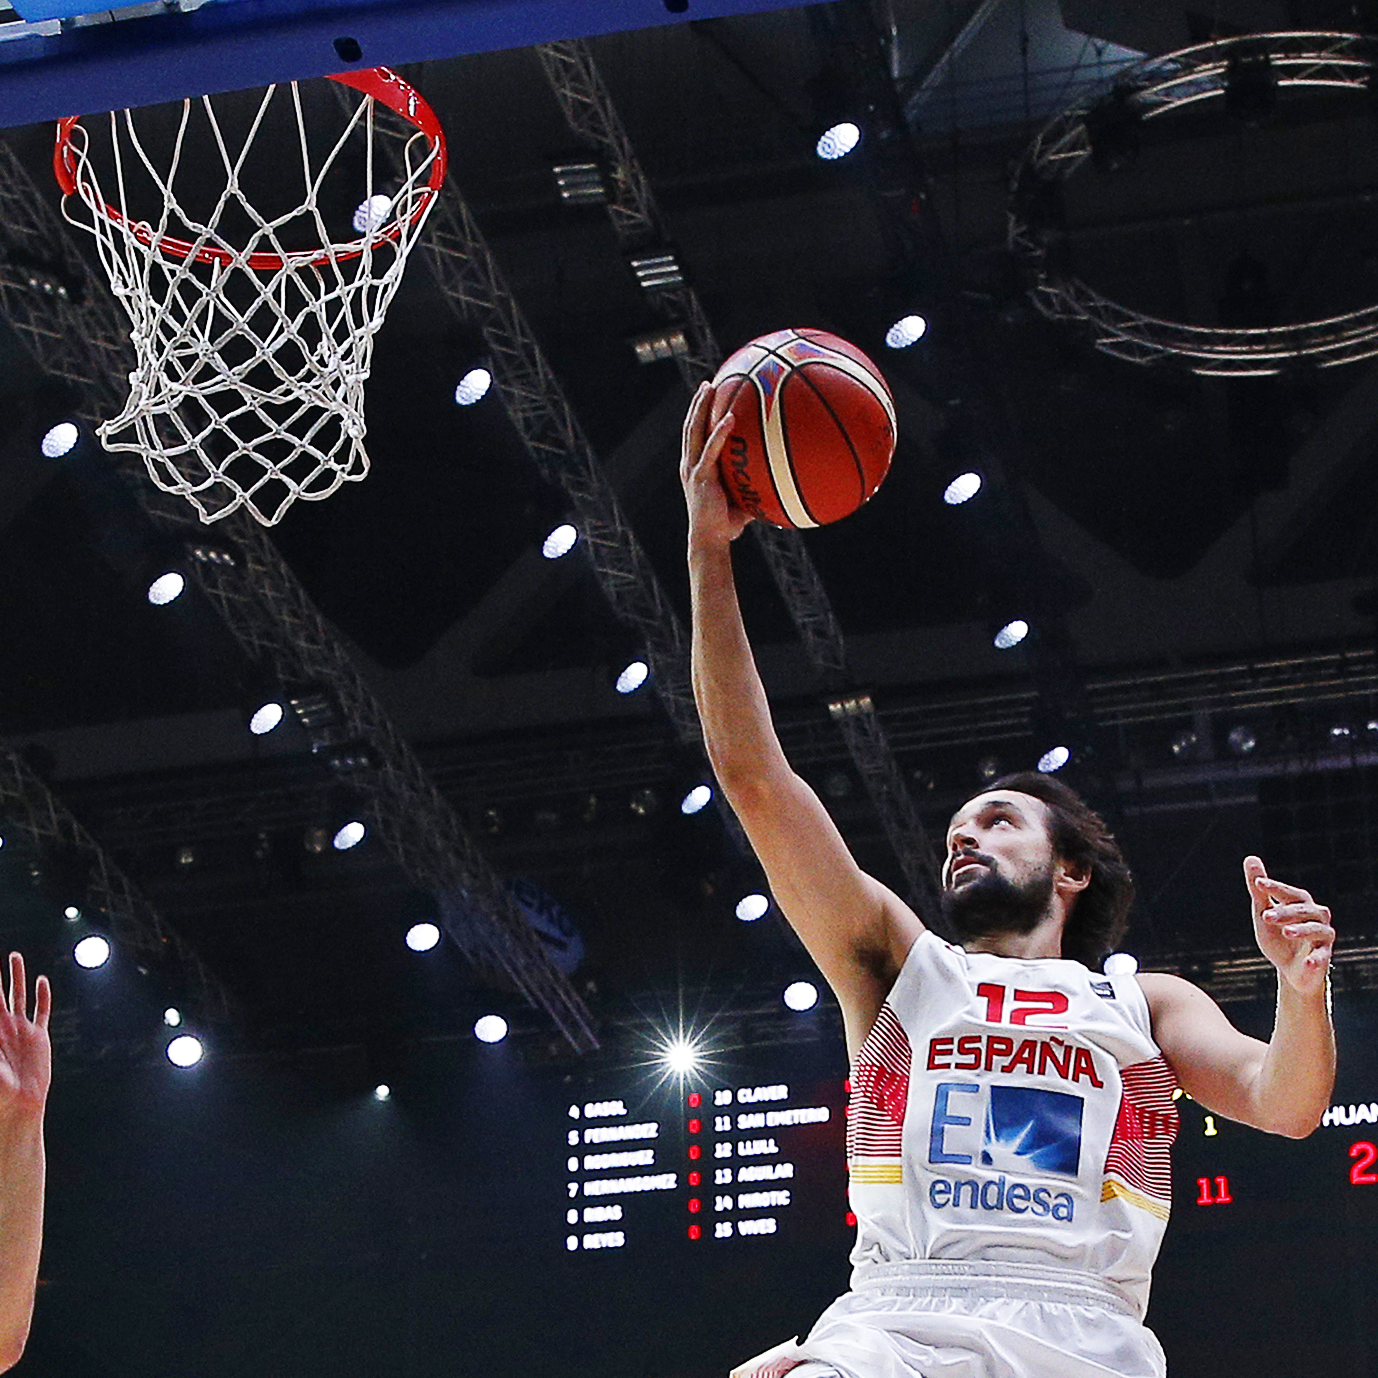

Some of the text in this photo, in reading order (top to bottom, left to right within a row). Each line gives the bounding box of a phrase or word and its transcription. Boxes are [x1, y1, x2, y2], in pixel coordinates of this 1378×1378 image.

[977, 982, 1069, 1029] 12
[927, 1035, 1104, 1088] ESPAÑA
[1205, 1117, 1217, 1135] 1
[568, 1183, 578, 1197] 7
[929, 1175, 1073, 1221] endesa
[1197, 1177, 1233, 1205] 11
